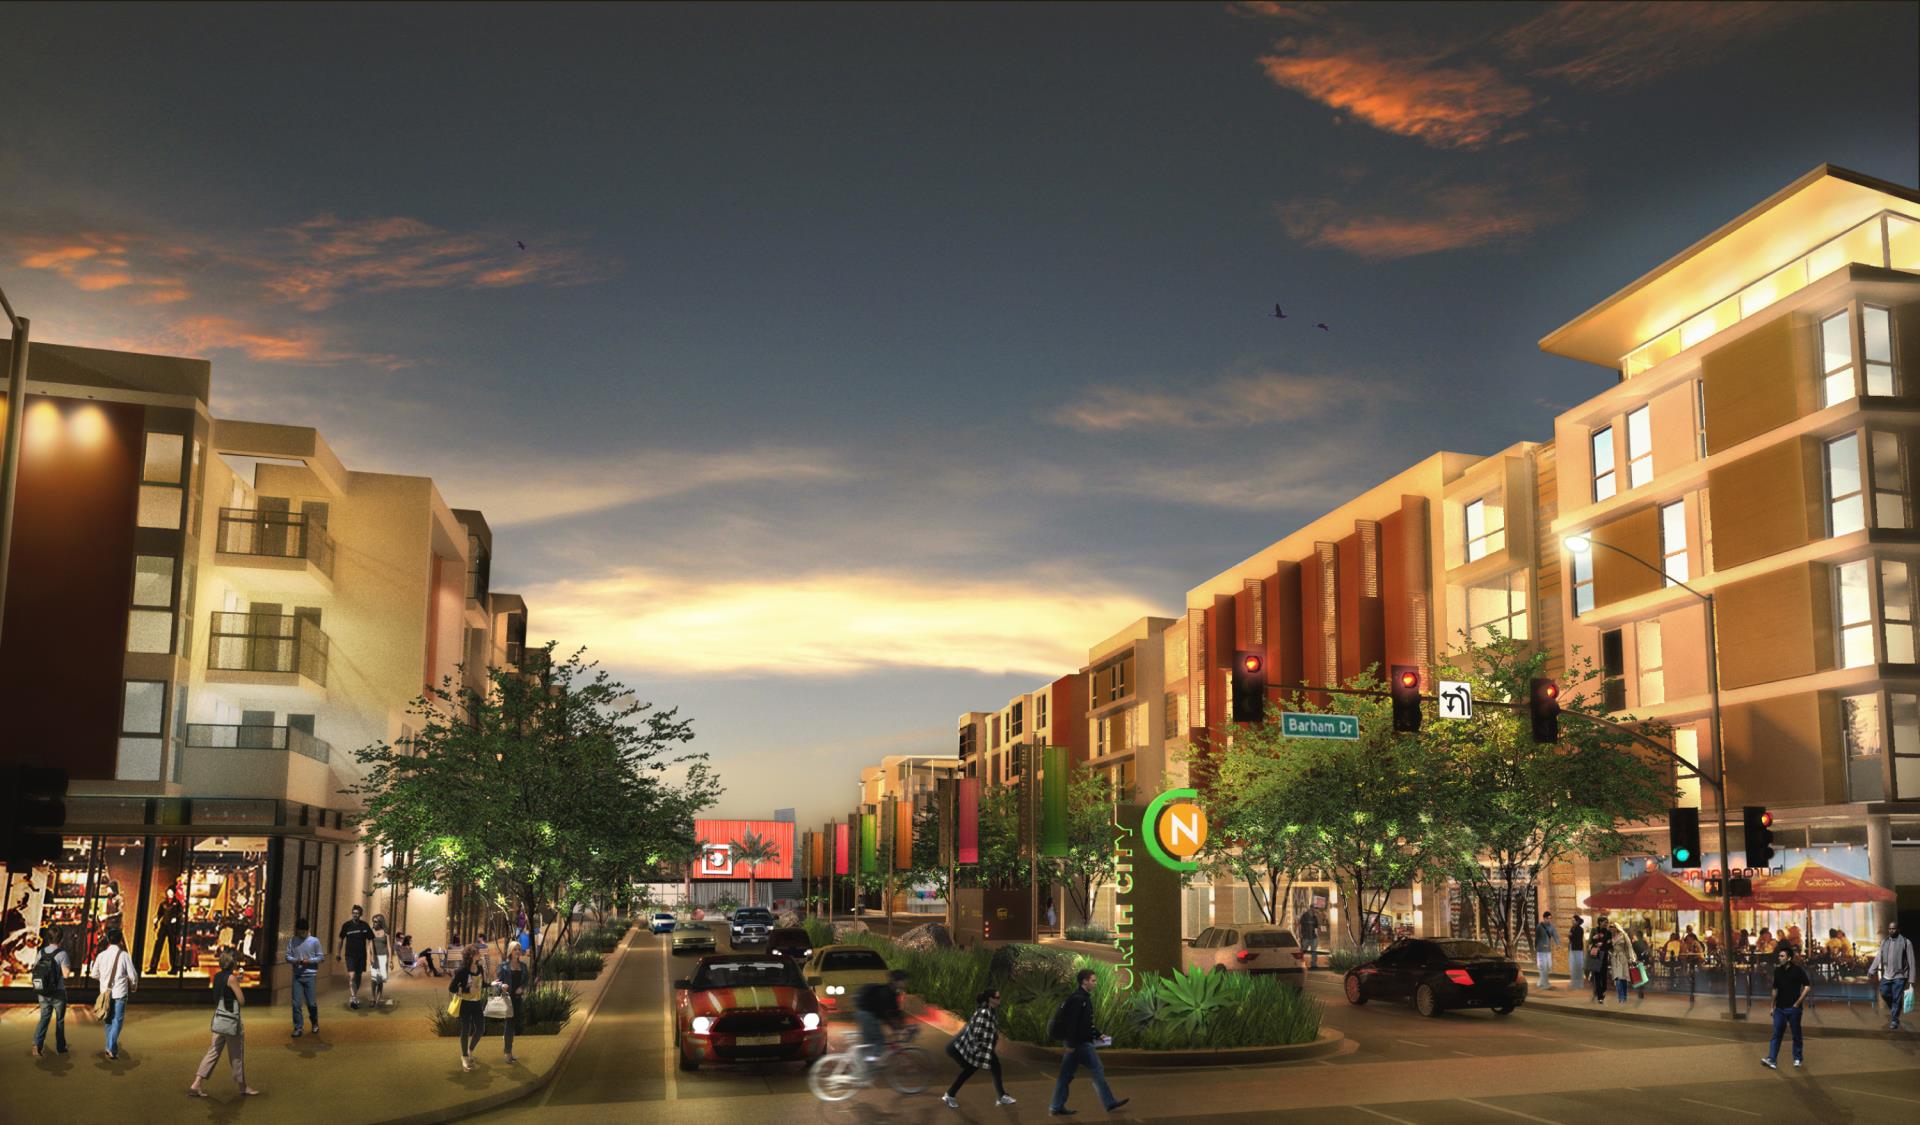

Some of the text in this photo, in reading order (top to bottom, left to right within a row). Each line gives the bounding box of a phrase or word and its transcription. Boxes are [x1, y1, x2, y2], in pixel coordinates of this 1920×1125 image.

[1288, 718, 1352, 734] Barham Dr
[1171, 813, 1198, 846] N
[1114, 822, 1134, 993] ORTH CITY
